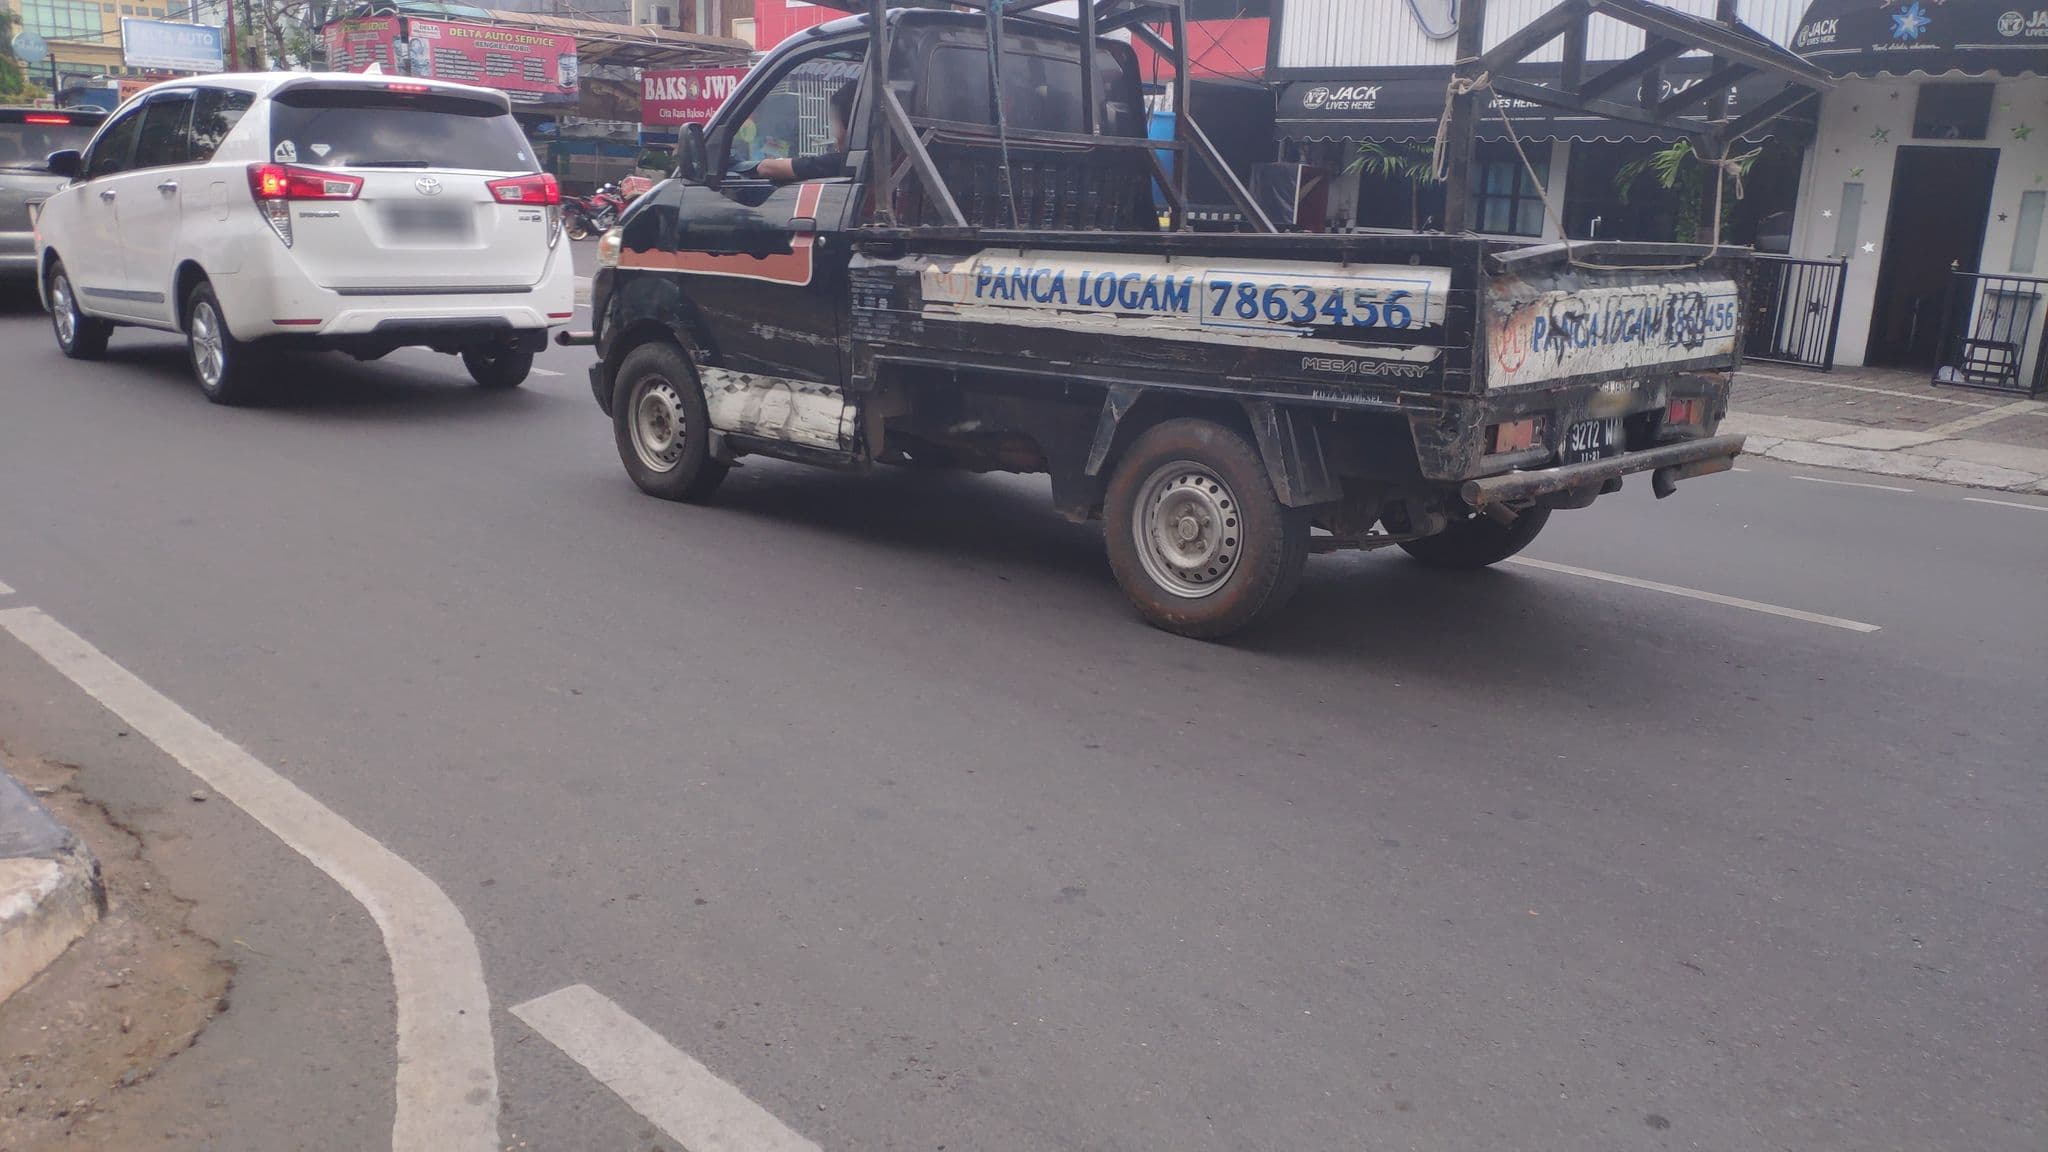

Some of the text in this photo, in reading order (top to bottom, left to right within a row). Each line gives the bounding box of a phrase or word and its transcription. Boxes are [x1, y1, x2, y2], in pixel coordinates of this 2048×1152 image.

[449, 27, 482, 39] DELTA
[484, 32, 513, 42] AUTO
[515, 34, 555, 47] SERVICE
[1808, 19, 1839, 37] JACK
[1329, 86, 1383, 100] JACK
[1325, 101, 1349, 110] LIVES
[975, 265, 1067, 305] PANCA
[1077, 270, 1195, 313] LOGAM
[1208, 280, 1413, 330] 7863456
[1302, 356, 1430, 378] MEGA CARRY
[1572, 420, 1600, 451] 9272
